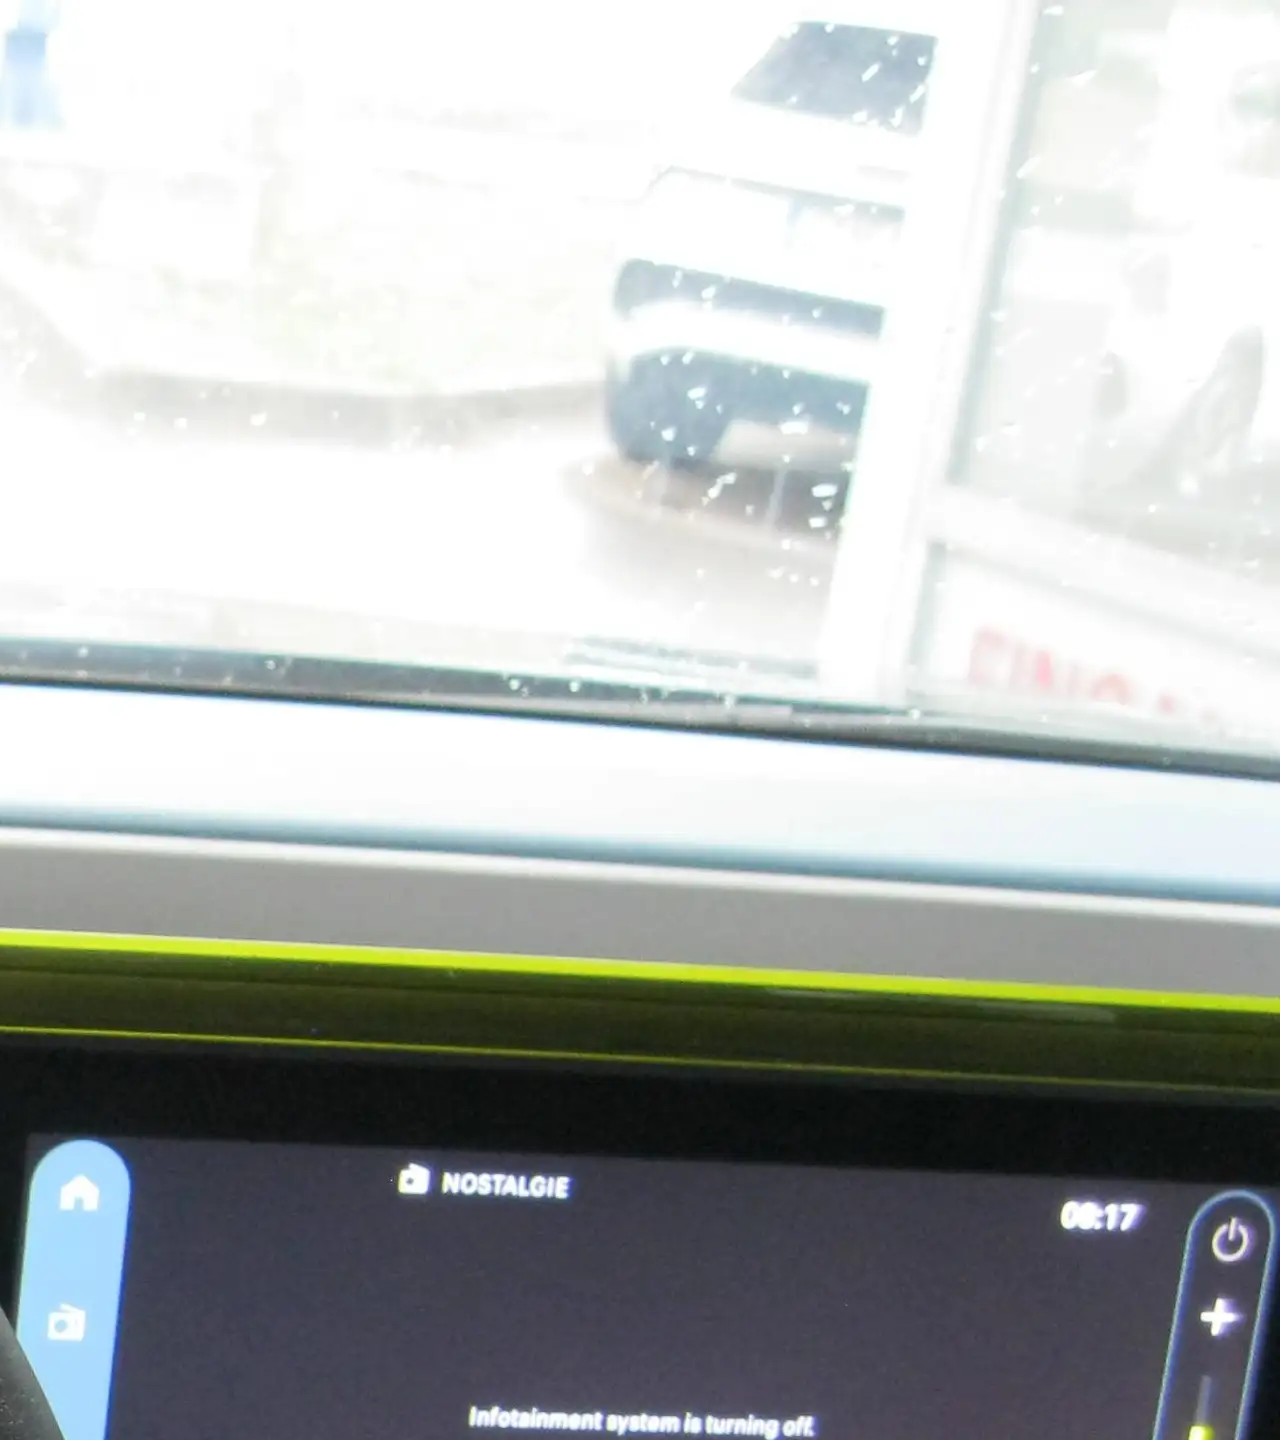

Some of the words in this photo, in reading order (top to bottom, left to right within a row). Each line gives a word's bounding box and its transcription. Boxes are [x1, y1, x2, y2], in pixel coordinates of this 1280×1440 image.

[442, 1171, 572, 1200] NOSTALGIE
[468, 1405, 603, 1431] Infotainment
[605, 1412, 682, 1437] system
[683, 1411, 702, 1435] is
